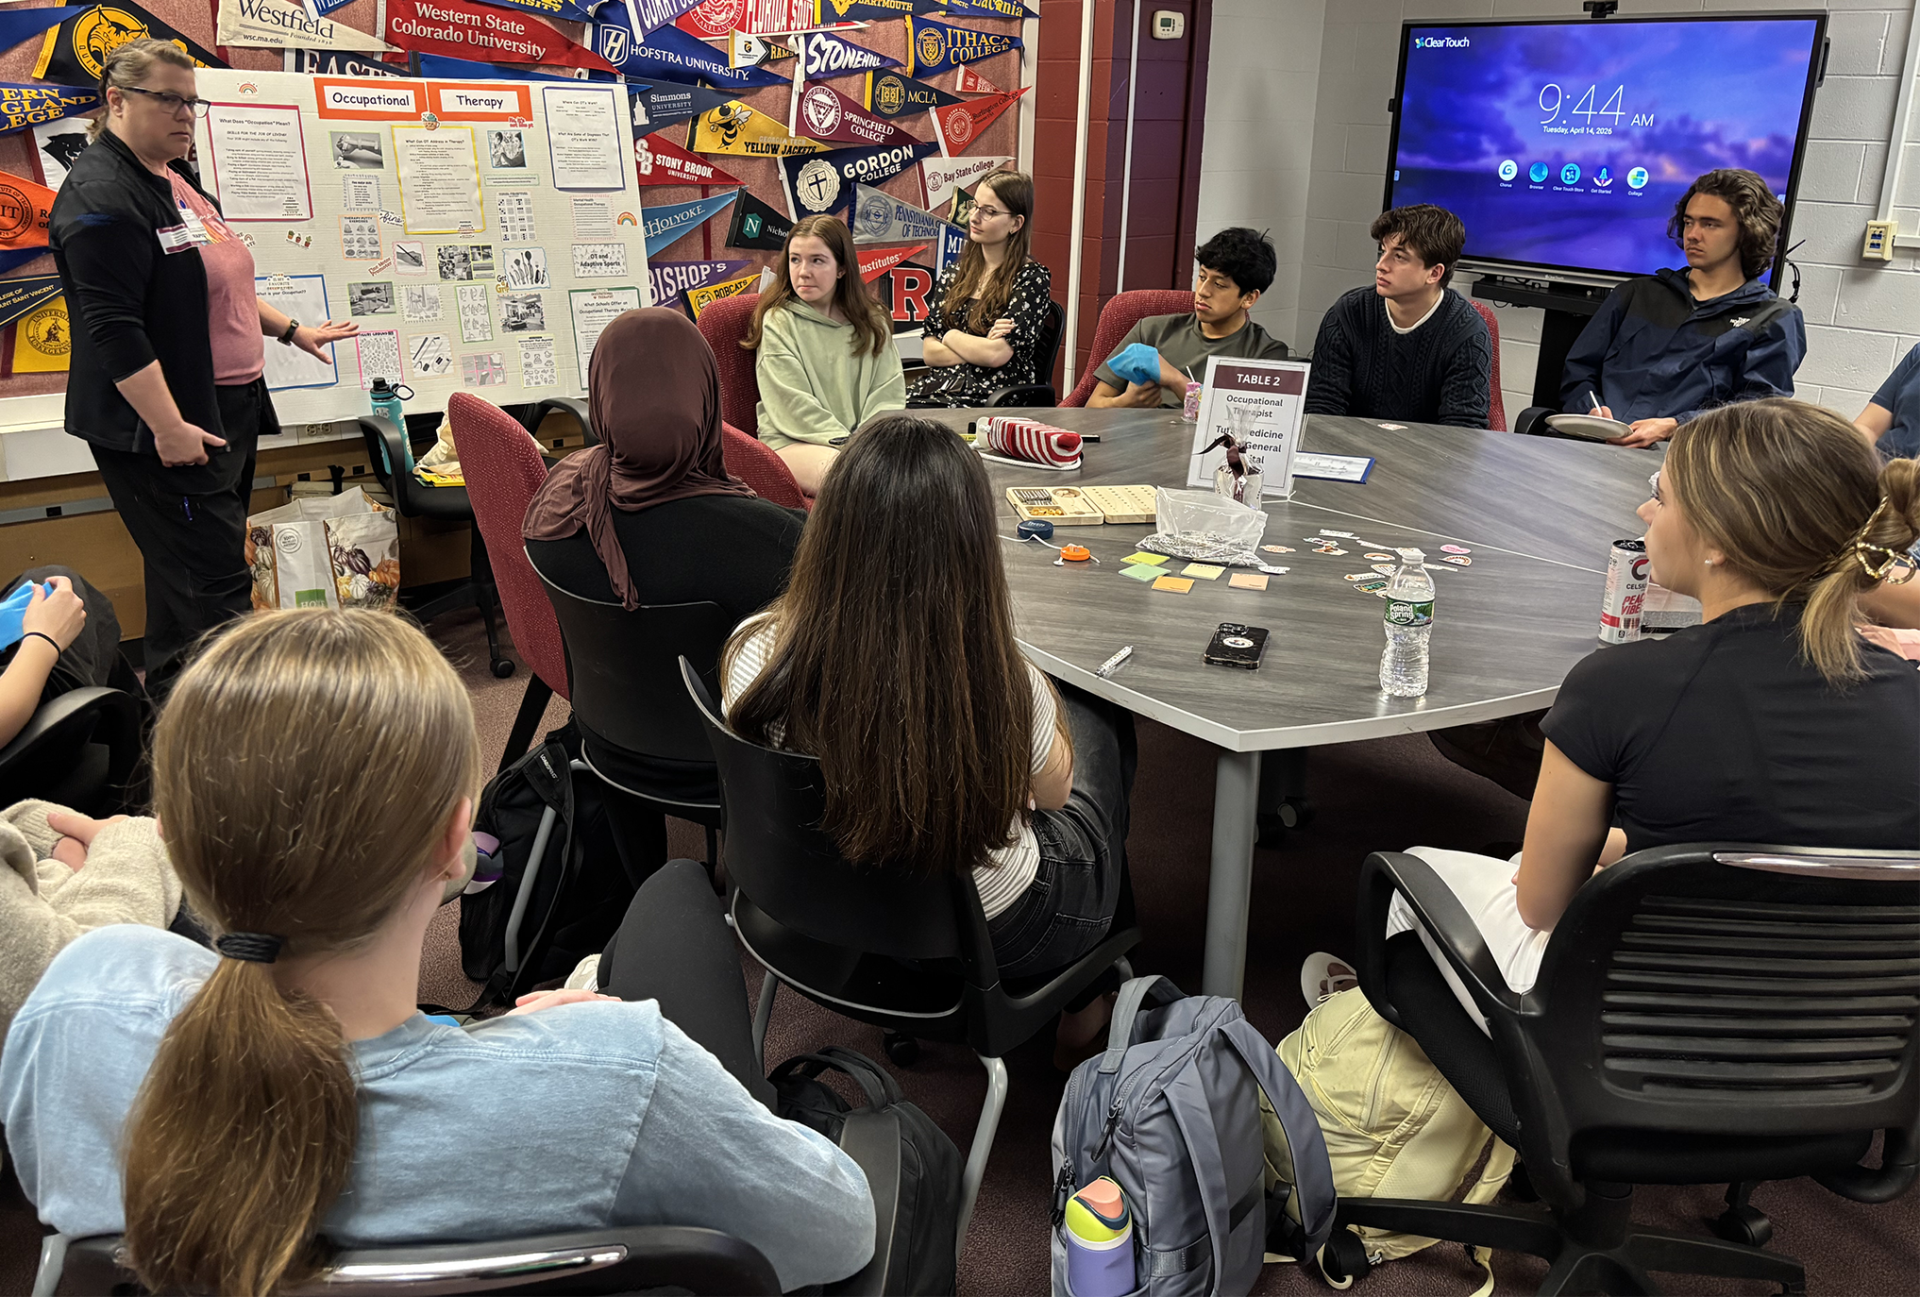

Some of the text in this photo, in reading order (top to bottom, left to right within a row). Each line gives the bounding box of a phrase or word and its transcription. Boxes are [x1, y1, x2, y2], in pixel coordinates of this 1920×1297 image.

[415, 2, 525, 35] Western State
[243, 34, 283, 44] wsc.ma.edu
[392, 17, 547, 61] Colorado University
[946, 28, 1011, 49] ITHACA
[806, 32, 881, 75] STONEHILL
[950, 44, 1009, 65] COLLEGE
[631, 44, 750, 81] HOFSTRA UNIVERSITY
[0, 87, 60, 101] ERN
[332, 91, 410, 108] Occupational
[650, 92, 691, 103] Simmons
[907, 90, 938, 104] MCLA
[456, 95, 504, 110] Therapy
[651, 102, 692, 111] UNIVERSITY
[1538, 83, 1655, 127] 9:44 AM
[844, 110, 894, 136] SPRINGFIELD
[1543, 125, 1613, 135] Tuesday, April 14, 2026
[759, 135, 787, 143] GEORGIA
[850, 124, 886, 143] COLLEGE
[744, 141, 817, 156] YELLOW JACKETS
[656, 154, 714, 179] STONY BROOK
[843, 144, 914, 179] GORDON
[667, 170, 698, 182] UNIVERSITY
[859, 163, 902, 183] COLLEGE
[943, 172, 956, 184] Bay
[955, 167, 973, 180] State
[972, 158, 995, 175] College
[650, 204, 705, 238] HOLYOKE
[894, 204, 935, 227] PENNSYLVANIA
[766, 224, 790, 240] Nichol
[902, 224, 911, 238] OF
[580, 260, 603, 268] Adaptive
[649, 261, 728, 300] BISHOP'S
[713, 277, 748, 300] BOBCATS
[0, 284, 55, 309] AINT SAINT VINCENT
[890, 267, 932, 322] R
[32, 310, 70, 323] UNIVERSIT
[1237, 373, 1281, 387] TABLE 2
[1226, 394, 1283, 407] Occupational
[1249, 428, 1284, 440] edicine
[1245, 441, 1282, 453] General
[1622, 592, 1646, 606] PEAC
[1390, 603, 1412, 612] Poland
[1390, 611, 1414, 621] Spring
